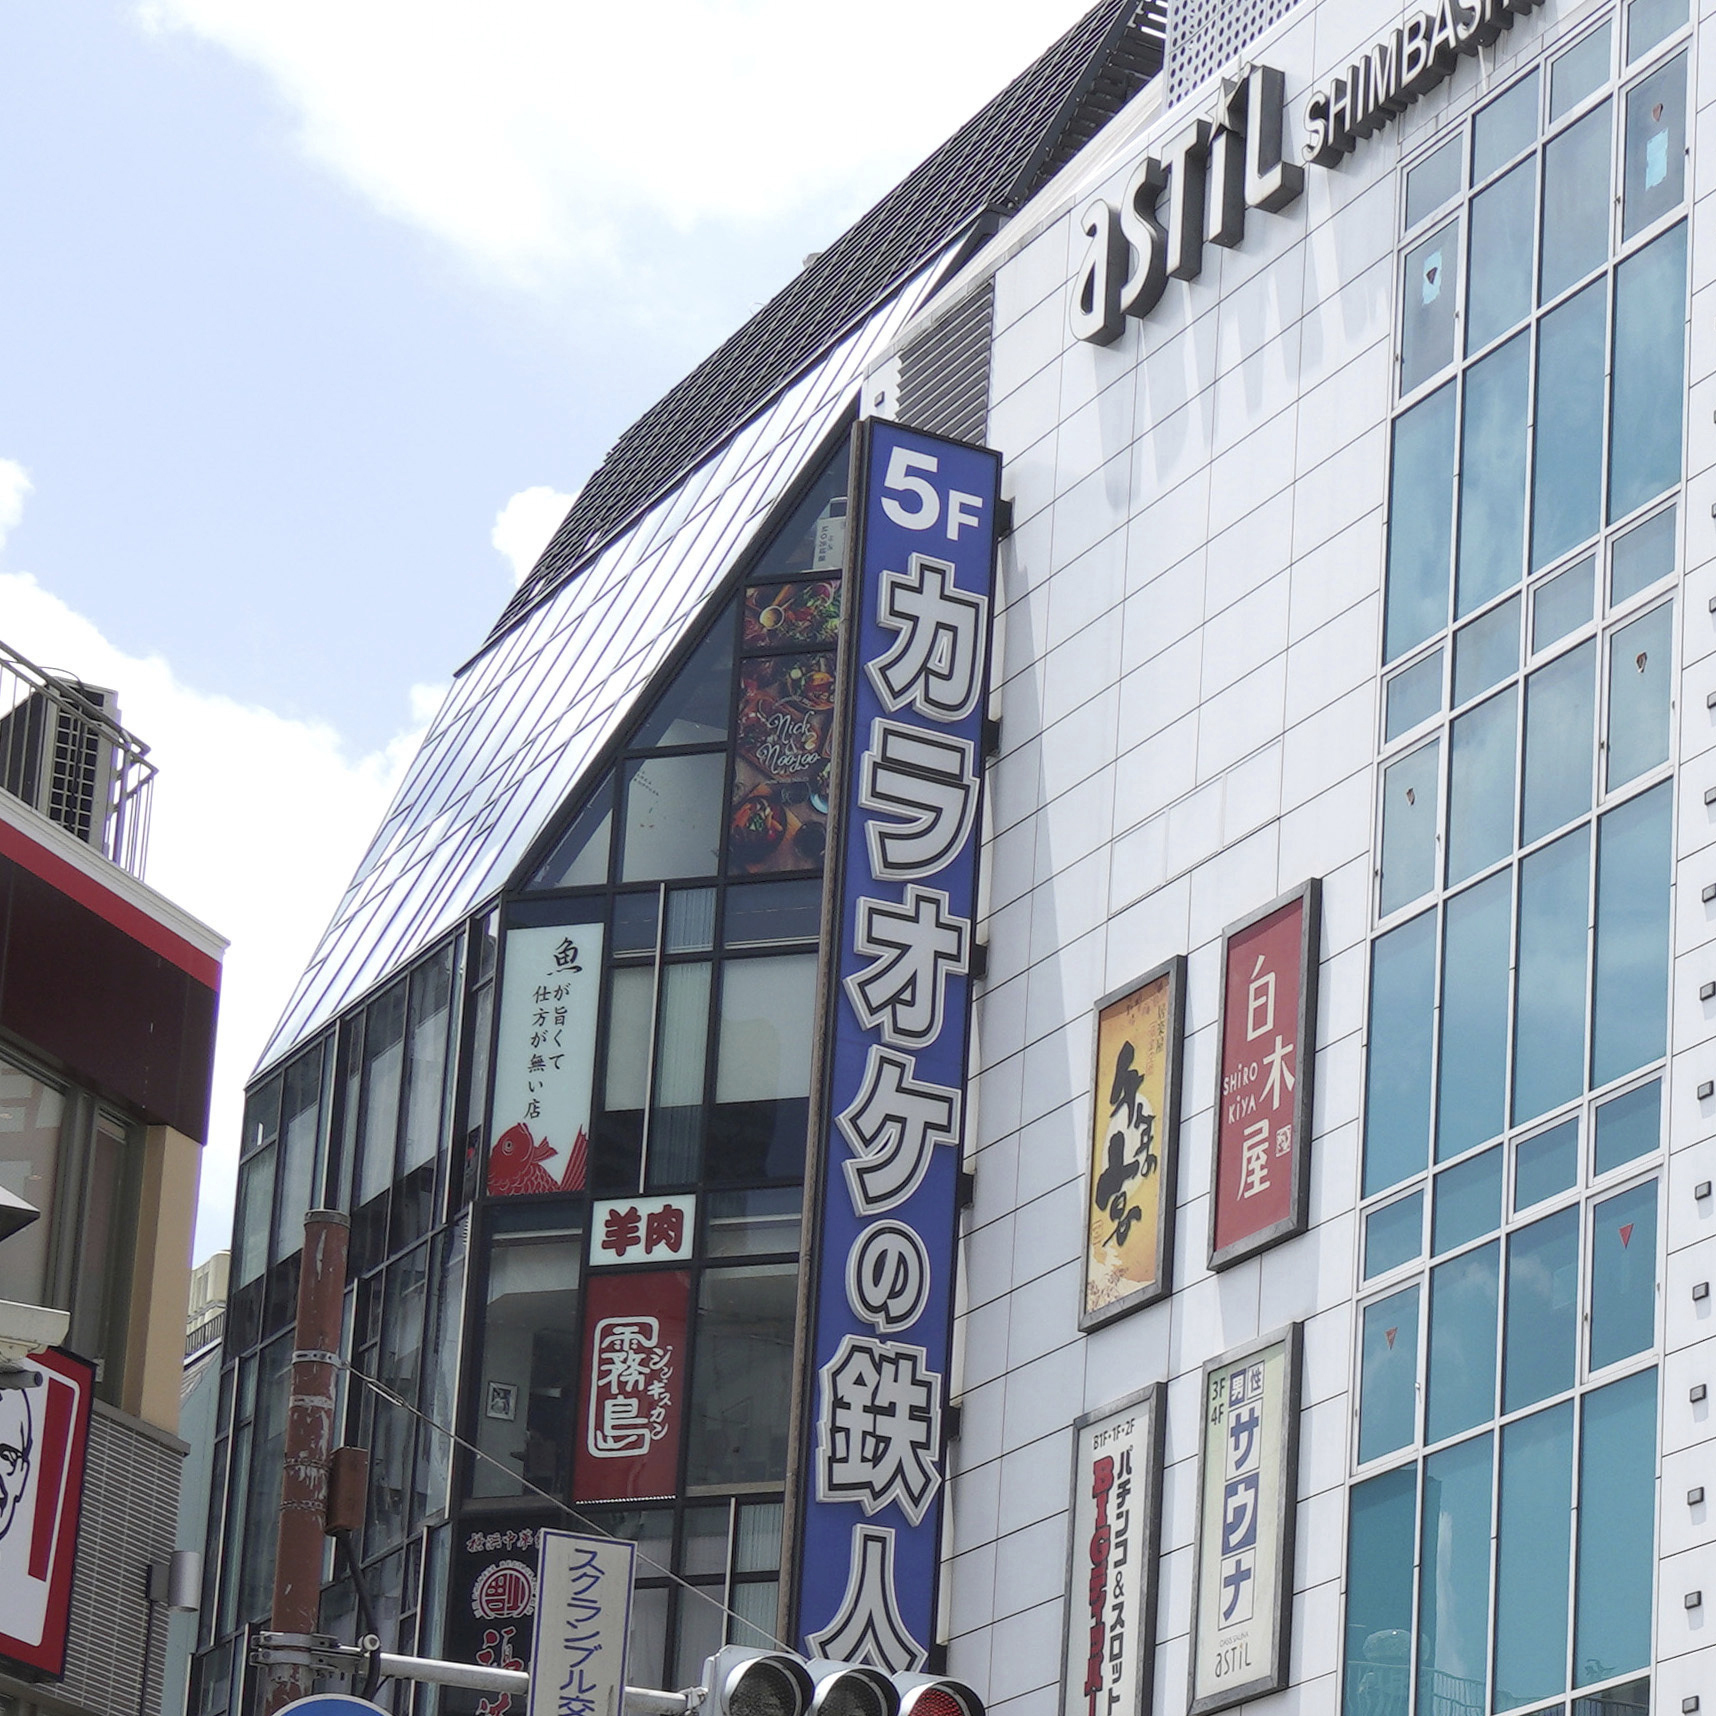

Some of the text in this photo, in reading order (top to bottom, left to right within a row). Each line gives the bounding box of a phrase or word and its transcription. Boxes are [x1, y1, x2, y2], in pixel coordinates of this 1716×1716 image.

[881, 446, 984, 542] 5F
[524, 984, 553, 1120] 仕方が無い店
[1237, 954, 1296, 1201] 白木屋
[806, 552, 988, 1673] カラオケの鉄人
[600, 1203, 685, 1256] 羊肉
[1211, 1403, 1225, 1427] 4F
[1213, 1378, 1226, 1401] 3F
[1107, 1445, 1133, 1716] パチンコ&スロット
